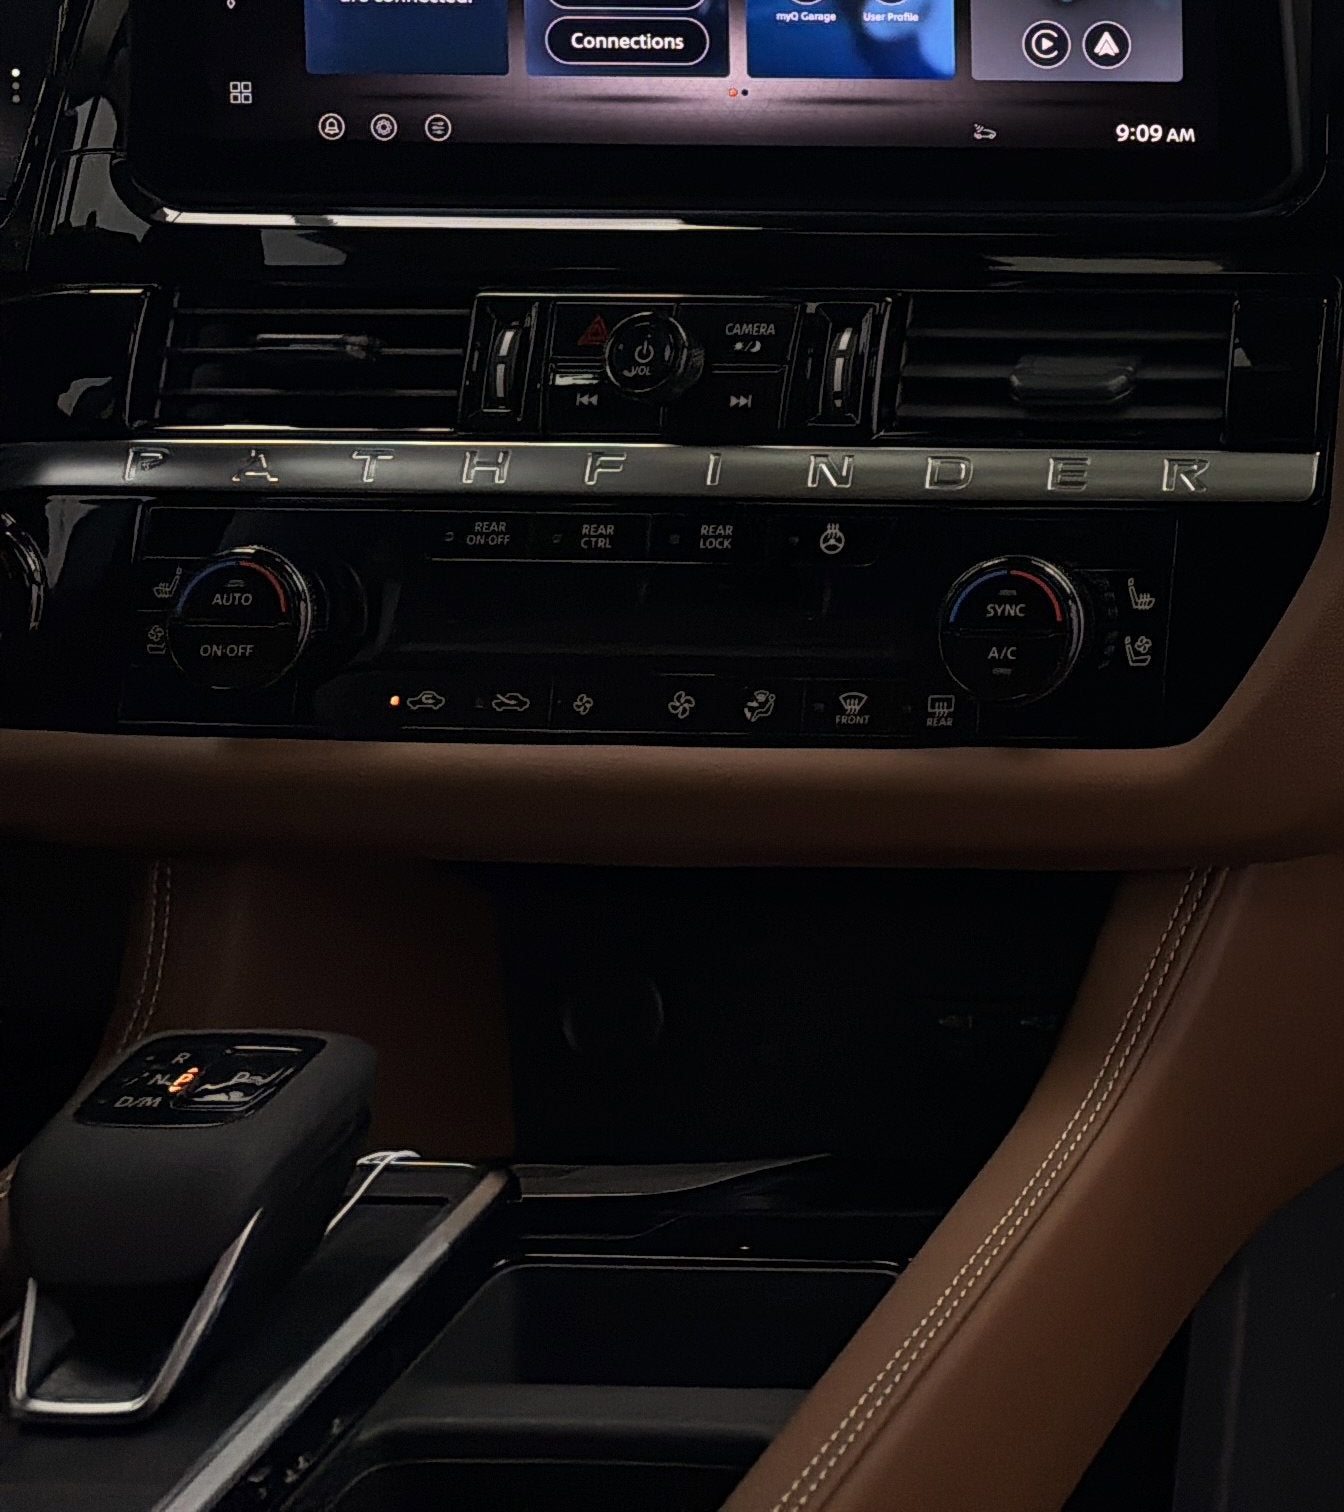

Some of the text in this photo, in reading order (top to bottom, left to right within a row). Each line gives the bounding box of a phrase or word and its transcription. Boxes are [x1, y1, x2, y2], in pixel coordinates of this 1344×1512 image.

[776, 11, 837, 24] myQ Garage
[863, 11, 919, 22] User Profile
[571, 32, 684, 51] Connections
[1115, 123, 1195, 143] 9:09 AM
[725, 323, 776, 336] CAMERA
[631, 366, 652, 376] VOL
[123, 446, 1210, 492] PATHFINDER
[474, 522, 507, 532] REAR
[581, 524, 614, 536] REAR
[700, 524, 733, 536] REAR
[580, 537, 612, 549] CTRL
[700, 537, 733, 549] LOCK
[211, 593, 253, 606] AUTO
[986, 603, 1026, 617] SYNC
[987, 647, 1017, 659] A/C
[835, 715, 870, 724] FRONT
[926, 718, 953, 726] REAR
[171, 1052, 191, 1064] R
[113, 1096, 162, 1108] D/M
